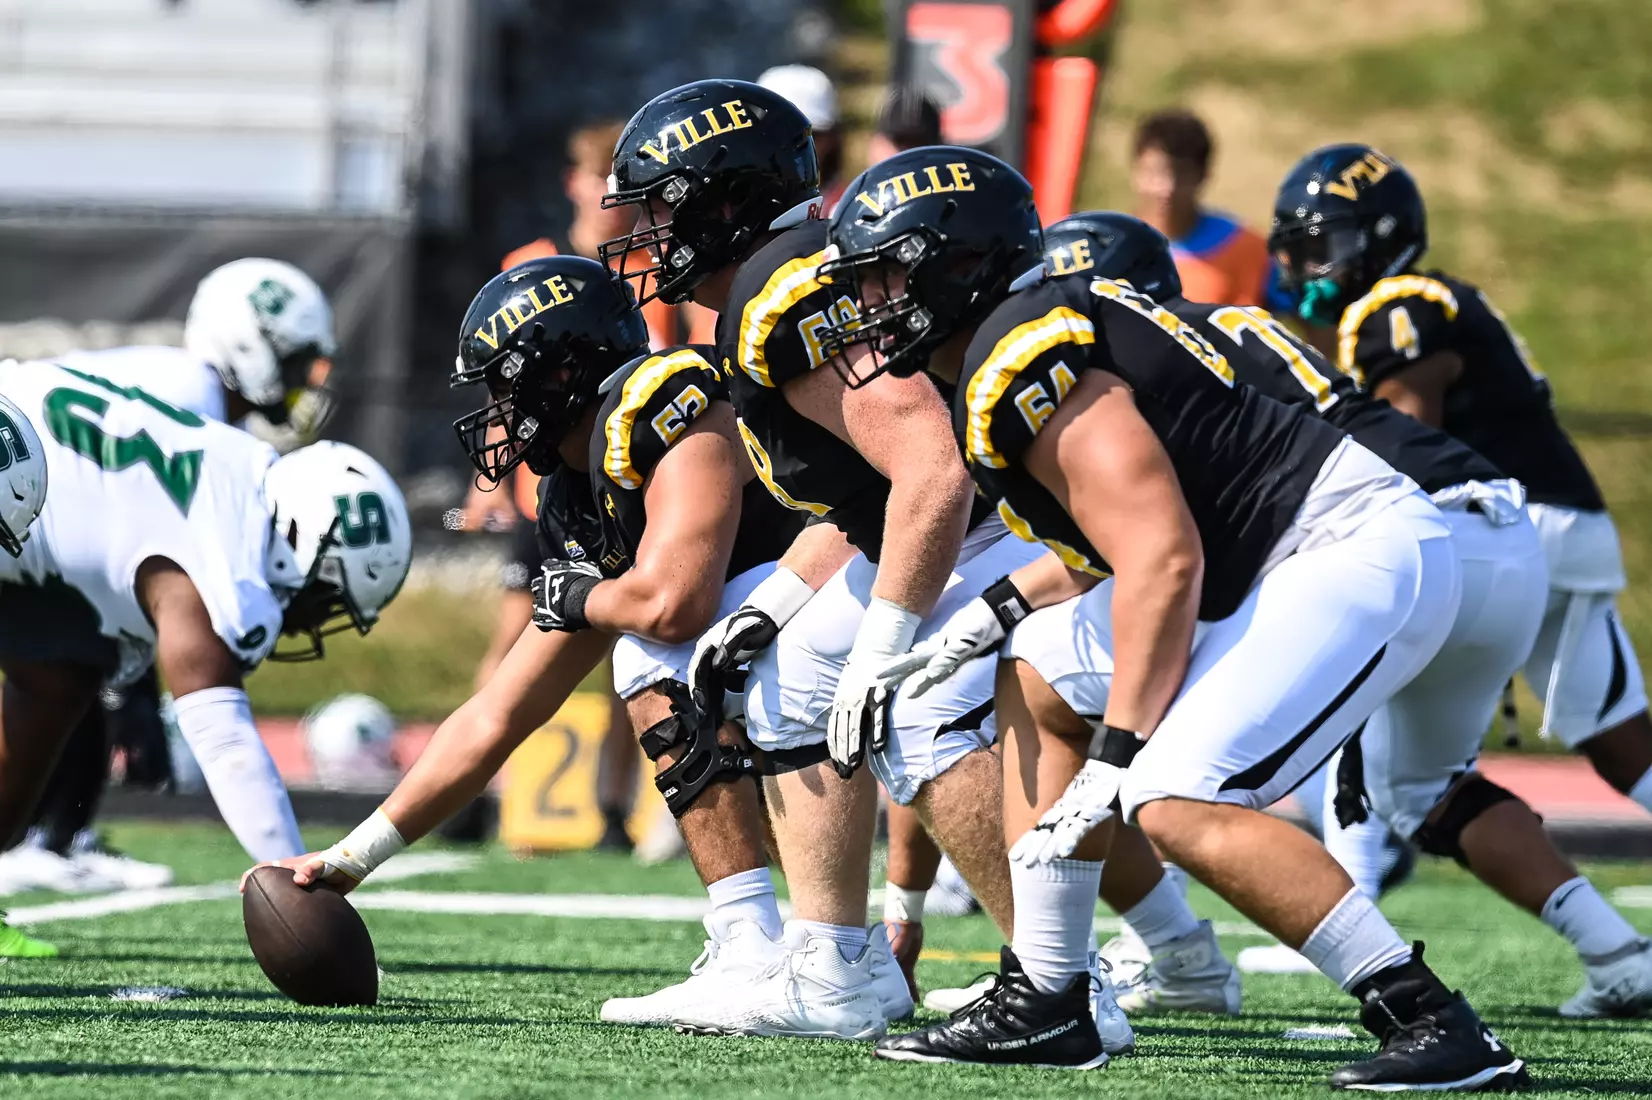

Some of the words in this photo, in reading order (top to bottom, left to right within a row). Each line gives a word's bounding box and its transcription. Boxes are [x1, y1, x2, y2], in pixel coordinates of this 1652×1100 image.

[906, 2, 1013, 145] 3
[639, 99, 753, 165] VILLE
[855, 162, 975, 217] VILLE
[1044, 238, 1095, 277] LE
[474, 274, 574, 350] VILLE
[1388, 305, 1420, 360] 4
[534, 722, 580, 818] 2
[987, 1038, 1028, 1051] UNDER
[1029, 1019, 1079, 1045] ARMOUR
